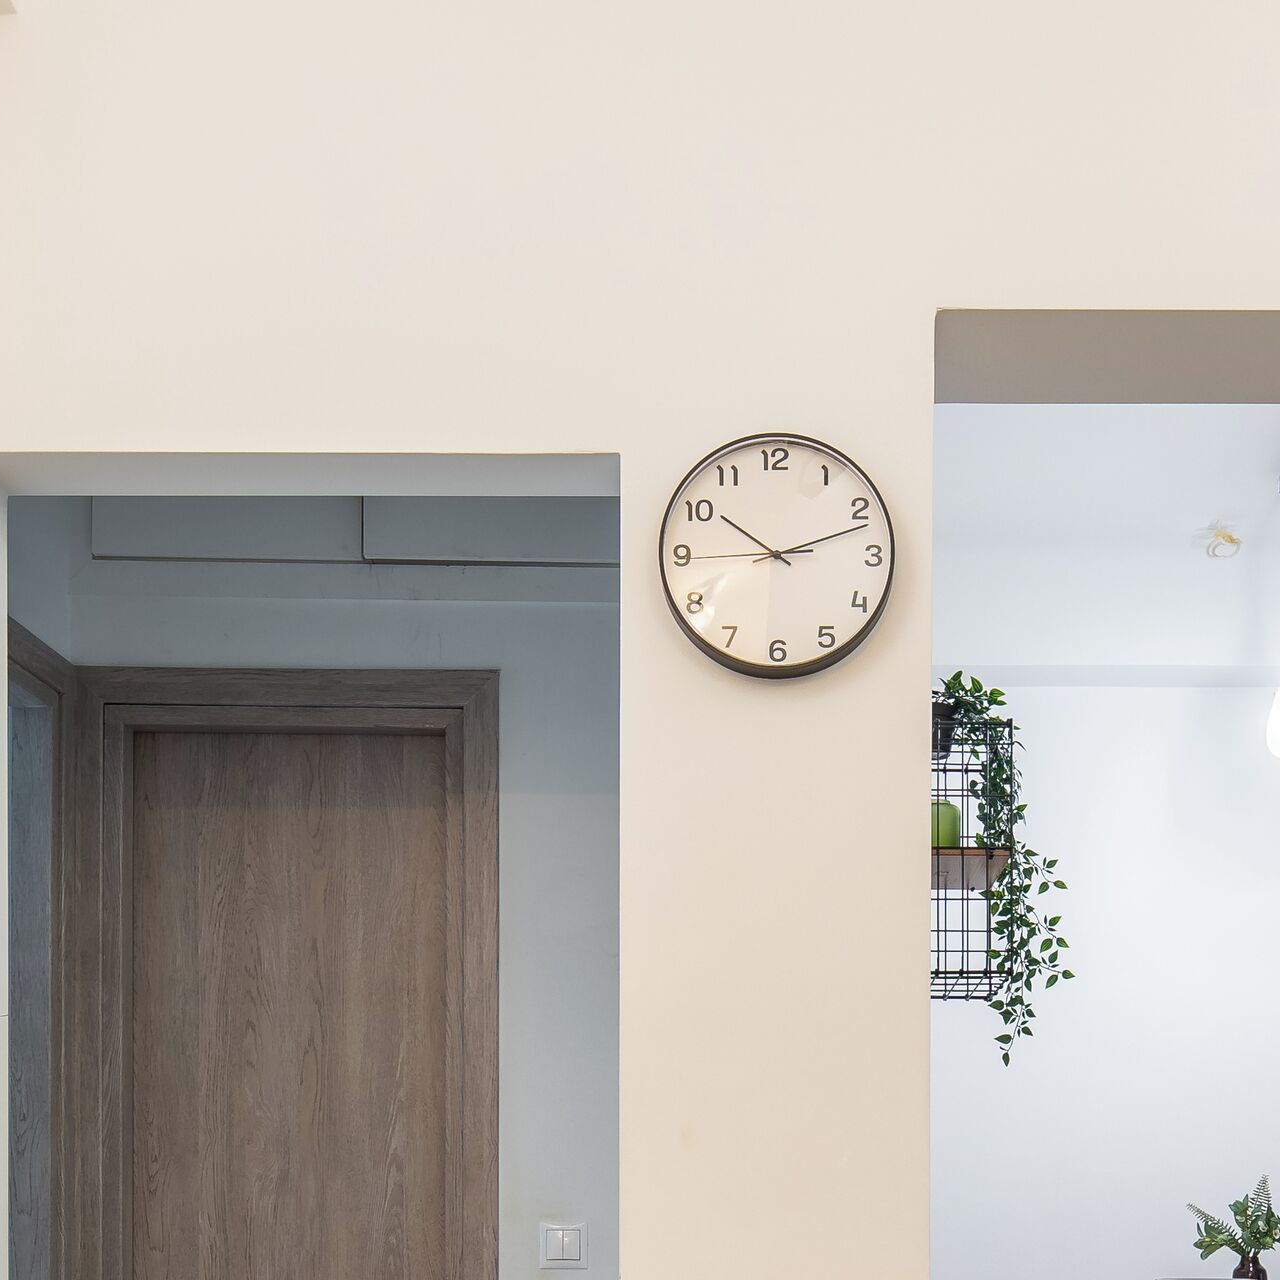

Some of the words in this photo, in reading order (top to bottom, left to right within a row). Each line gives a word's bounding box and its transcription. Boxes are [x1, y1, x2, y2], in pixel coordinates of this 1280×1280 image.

[761, 448, 789, 470] 12
[717, 464, 738, 486] 11
[822, 464, 828, 486] 1
[686, 500, 713, 522] 10
[851, 498, 870, 520] 2
[673, 544, 691, 566] 9
[864, 544, 882, 567] 3
[686, 592, 704, 614] 8
[852, 591, 868, 613] 4
[722, 626, 738, 648] 7
[818, 626, 836, 648] 5
[769, 640, 787, 662] 6
